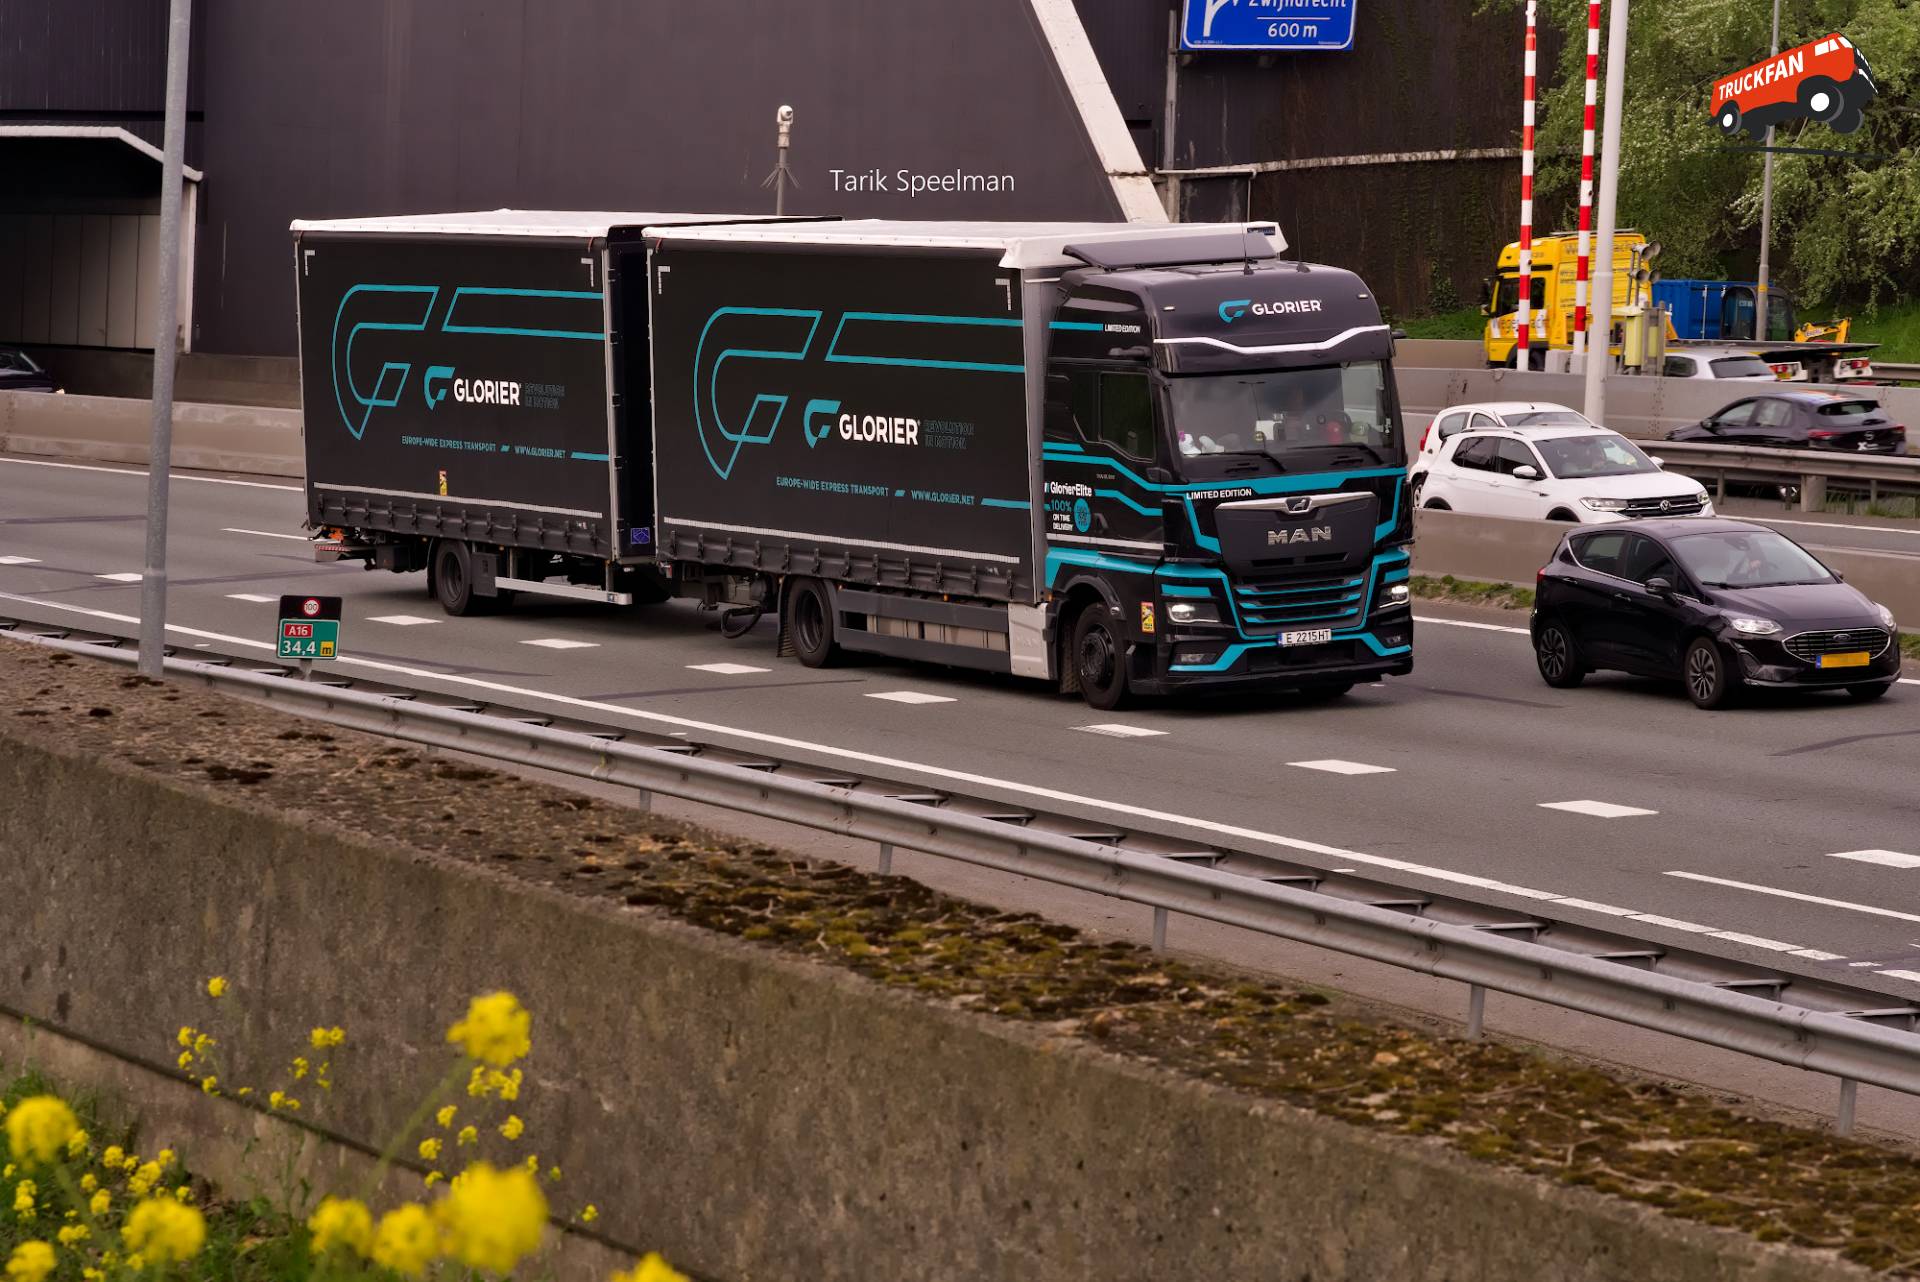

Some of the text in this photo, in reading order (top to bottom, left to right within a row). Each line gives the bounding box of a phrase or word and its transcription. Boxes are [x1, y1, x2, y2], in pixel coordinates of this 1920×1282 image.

[1268, 23, 1318, 38] 600 m
[1252, 300, 1322, 316] GLORIER
[1122, 325, 1141, 333] EDITION
[453, 378, 520, 406] GLORIER
[838, 413, 918, 445] GLORIER
[402, 436, 566, 459] EUROPE-WIDE EXPRESS TRANSPORT WWW.GLORIER.NET
[776, 477, 975, 505] EUROPE-WIDE EXPRESS TRANSPORT WWW.GLORIER.NET
[1050, 482, 1092, 497] GlorierElite
[1186, 489, 1252, 500] LIMITED EDITION
[1051, 499, 1072, 512] 100%
[1053, 513, 1071, 522] ON TIME
[1052, 522, 1073, 531] DELIVERY
[1267, 526, 1331, 545] MAN
[304, 603, 318, 611] 100
[288, 626, 308, 636] A16
[1286, 633, 1292, 643] E
[282, 640, 316, 656] 34,4
